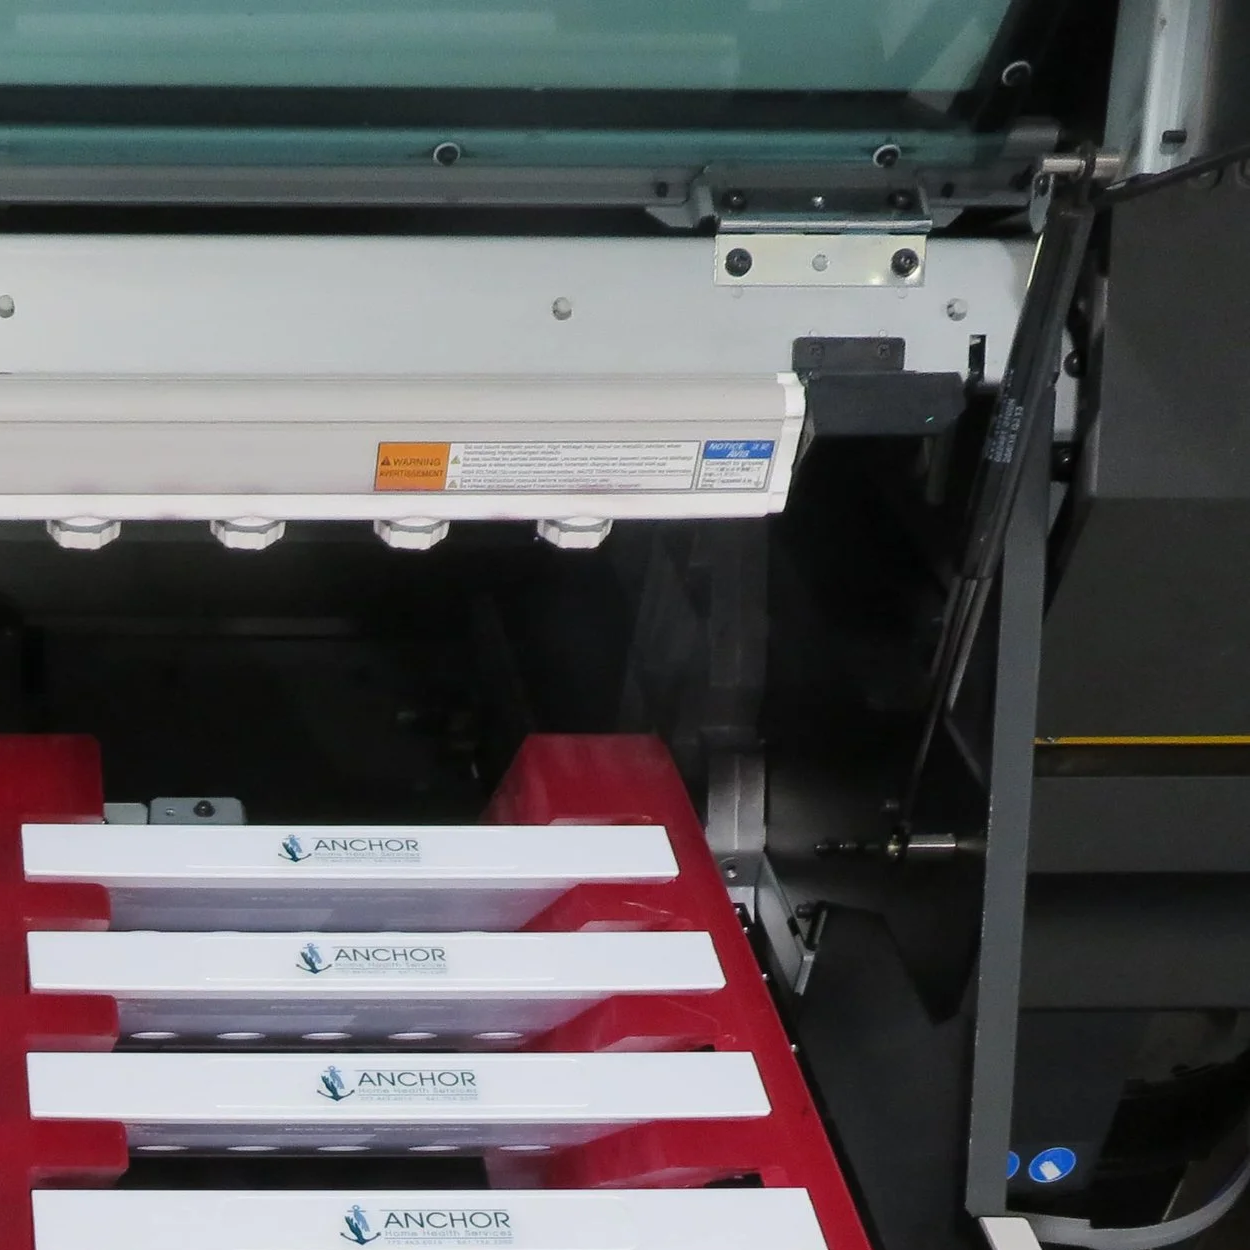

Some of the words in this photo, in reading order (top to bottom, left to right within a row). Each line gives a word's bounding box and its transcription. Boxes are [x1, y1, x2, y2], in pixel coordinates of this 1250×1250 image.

[709, 443, 745, 451] NOTICE
[726, 450, 750, 458] AVIS
[393, 458, 442, 467] WARNING
[379, 469, 445, 478] AVERTISSEMENT
[315, 839, 419, 852] ANCHOR
[334, 948, 446, 962] ANCHOR
[358, 1071, 477, 1087] ANCHOR
[384, 1212, 511, 1229] ANCHOR
[384, 1229, 418, 1237] Home
[422, 1229, 459, 1237] Health
[464, 1229, 512, 1237] Services
